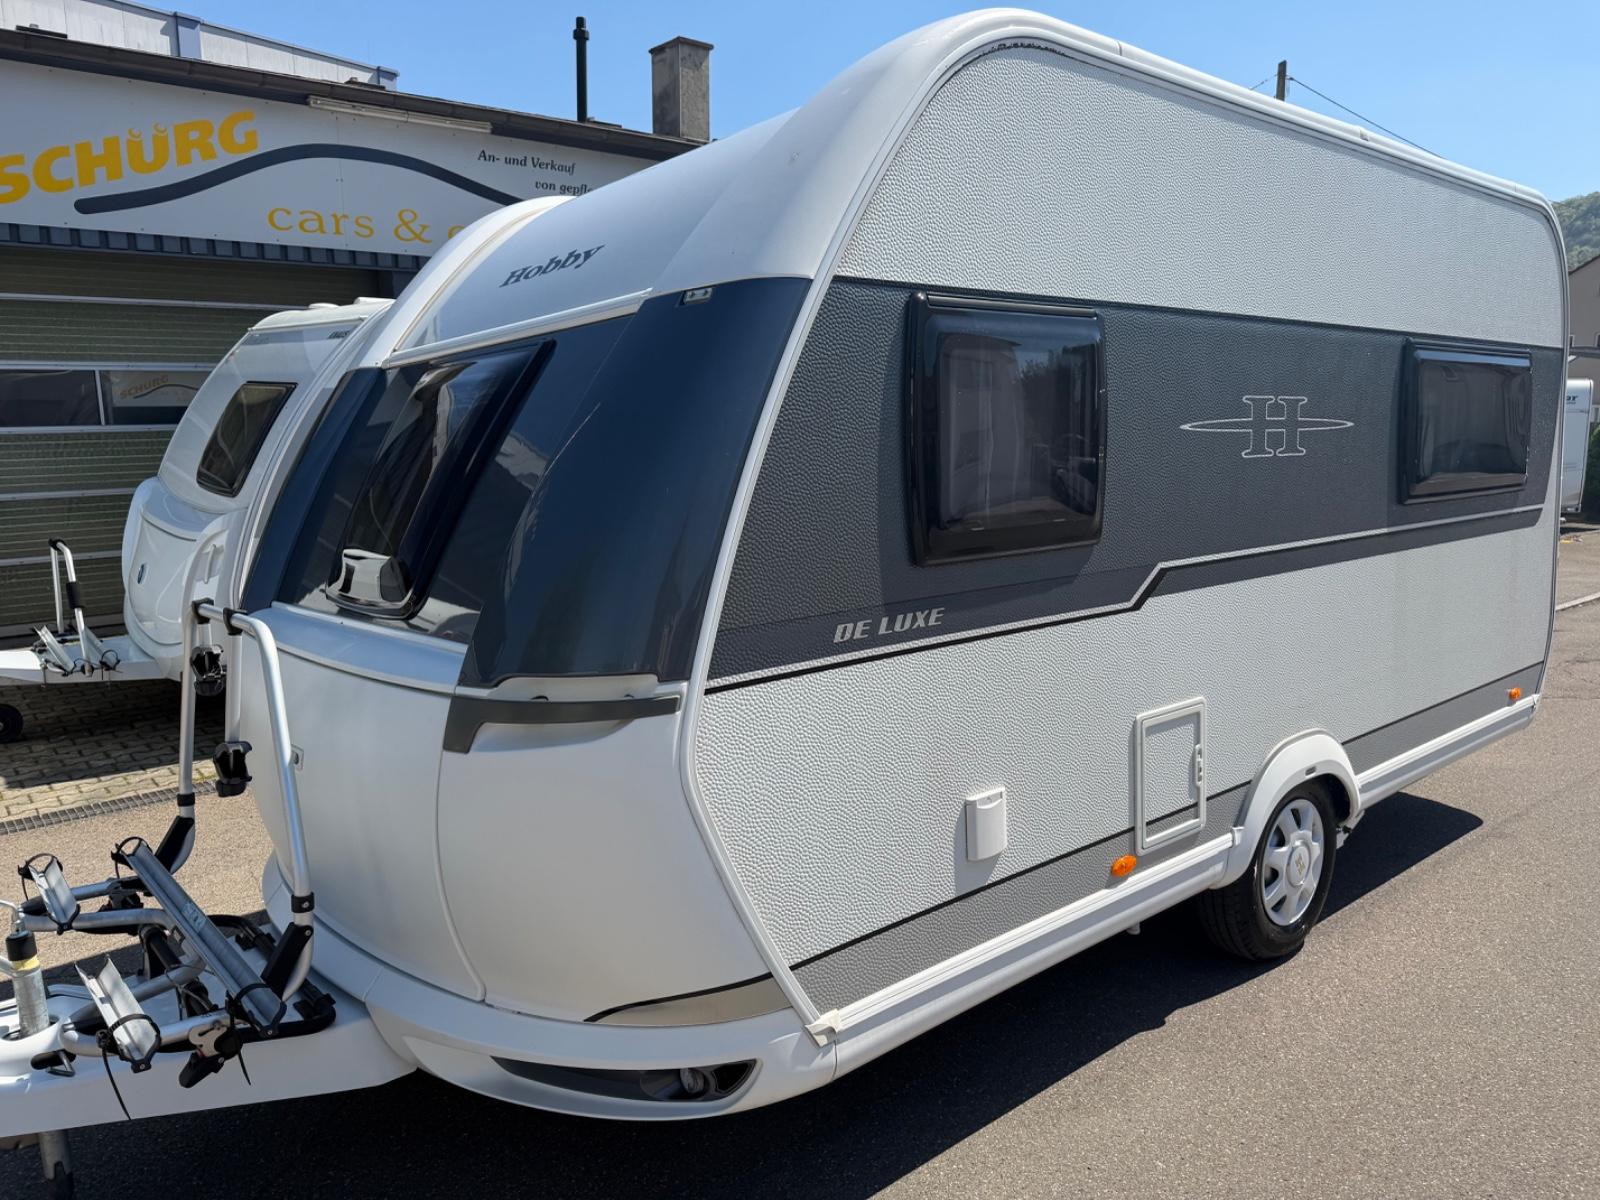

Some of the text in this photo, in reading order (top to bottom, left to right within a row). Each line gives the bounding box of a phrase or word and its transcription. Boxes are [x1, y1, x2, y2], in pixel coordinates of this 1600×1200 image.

[477, 150, 576, 176] An- und Verkauf
[535, 181, 556, 191] von
[267, 207, 374, 239] cars
[393, 208, 433, 244] &
[499, 244, 605, 288] Hobby
[833, 607, 945, 644] DE LUXE
